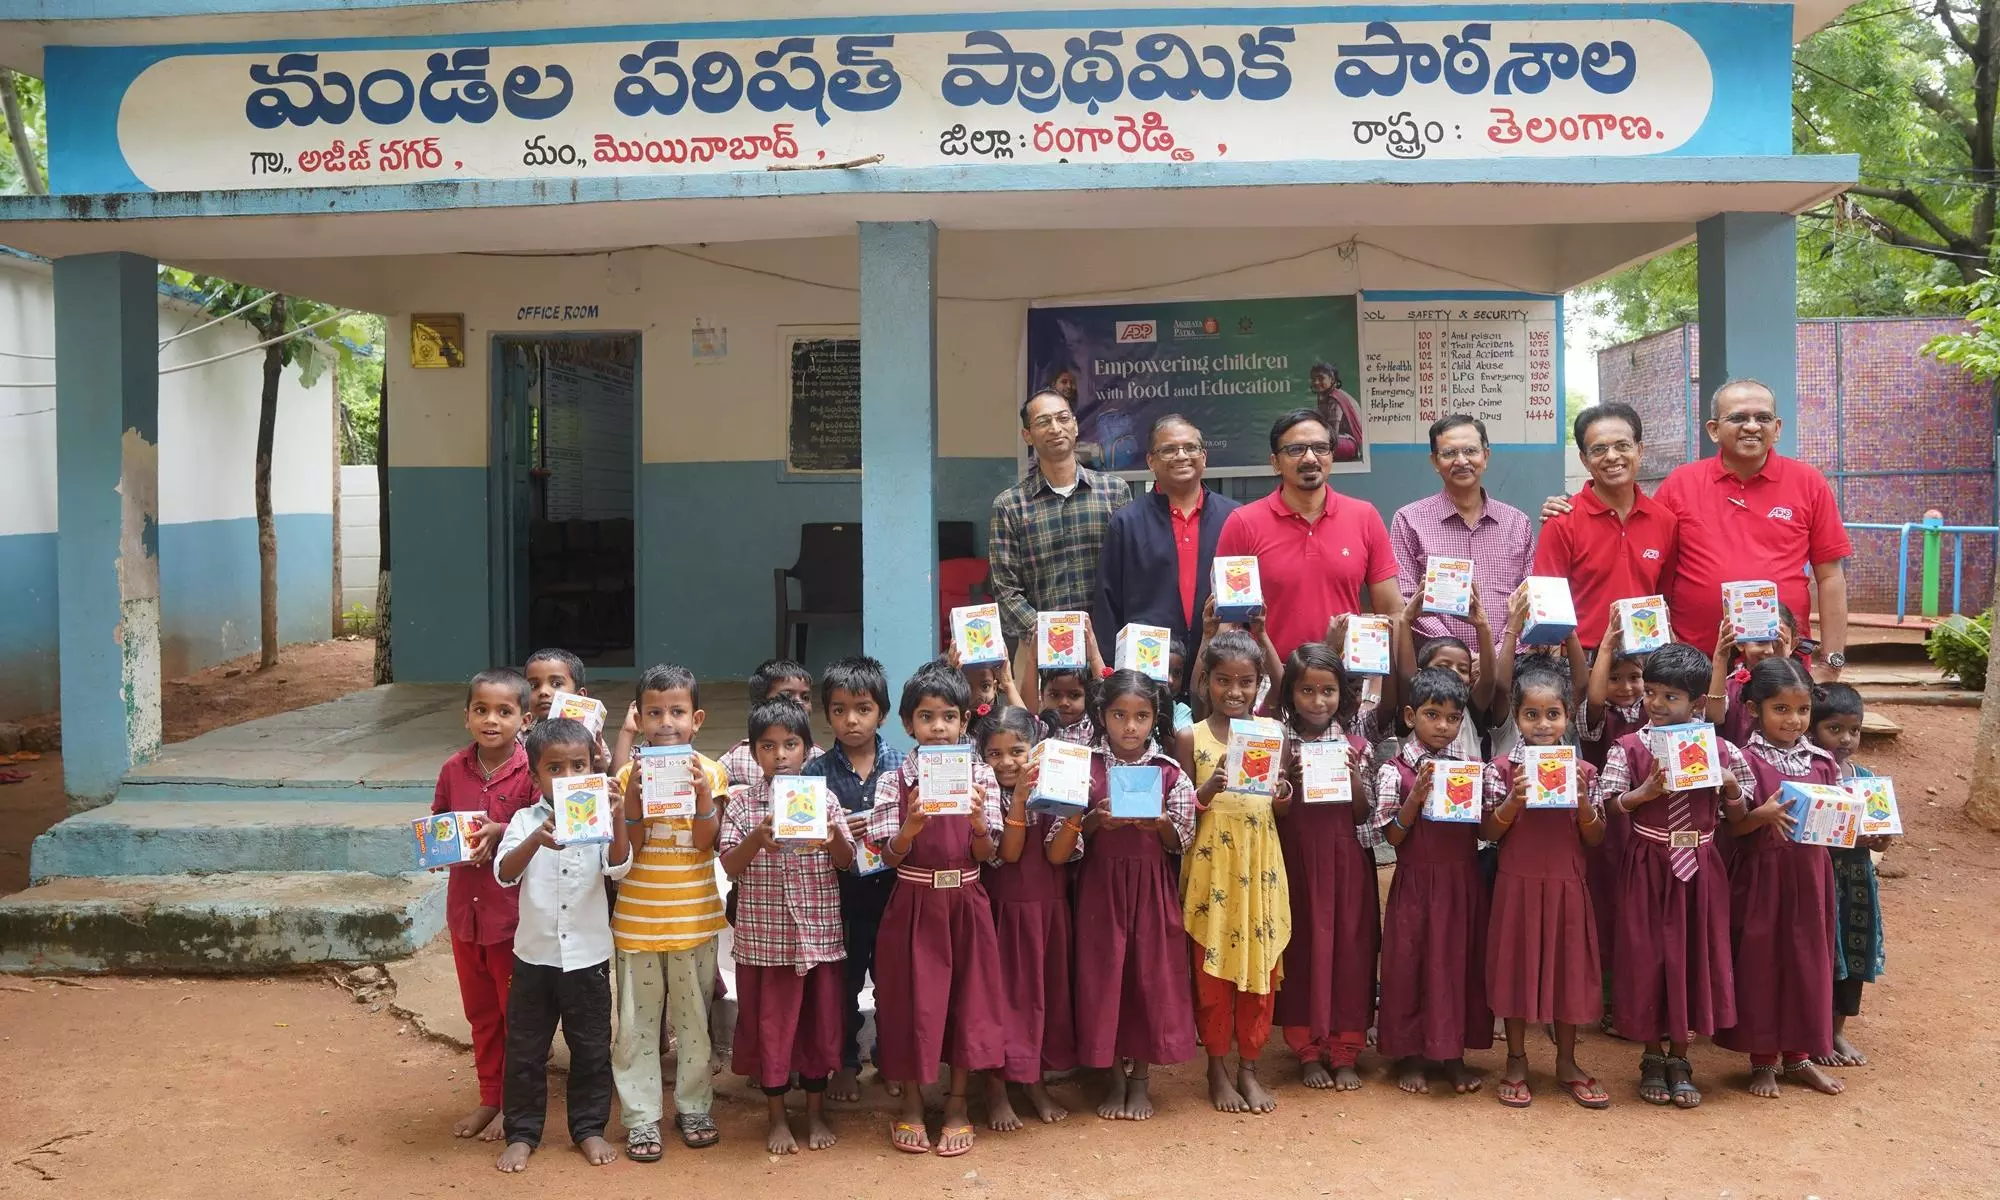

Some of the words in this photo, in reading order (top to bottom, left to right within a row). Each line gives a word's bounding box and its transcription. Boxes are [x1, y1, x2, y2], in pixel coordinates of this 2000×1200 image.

[245, 47, 574, 129] మండల
[613, 35, 902, 127] పరిషత్
[1334, 21, 1637, 98] పాఠశాల
[517, 306, 560, 320] OFFICE
[563, 305, 599, 320] ROOM
[1407, 309, 1451, 320] SAFETY
[1473, 310, 1528, 320] SECURITY
[1121, 324, 1152, 340] ADP
[1418, 331, 1432, 340] 100
[1418, 341, 1431, 350] 101
[1094, 355, 1209, 378] Empowering
[1212, 353, 1288, 372] children
[1476, 360, 1504, 370] Abuse
[1453, 372, 1474, 381] LPG
[1480, 372, 1525, 383] Emergency
[1095, 387, 1123, 400] with
[1128, 381, 1169, 399] food
[1173, 383, 1198, 397] and
[1201, 377, 1291, 396] Education
[1452, 384, 1475, 394] Blood
[1480, 411, 1502, 421] Drug
